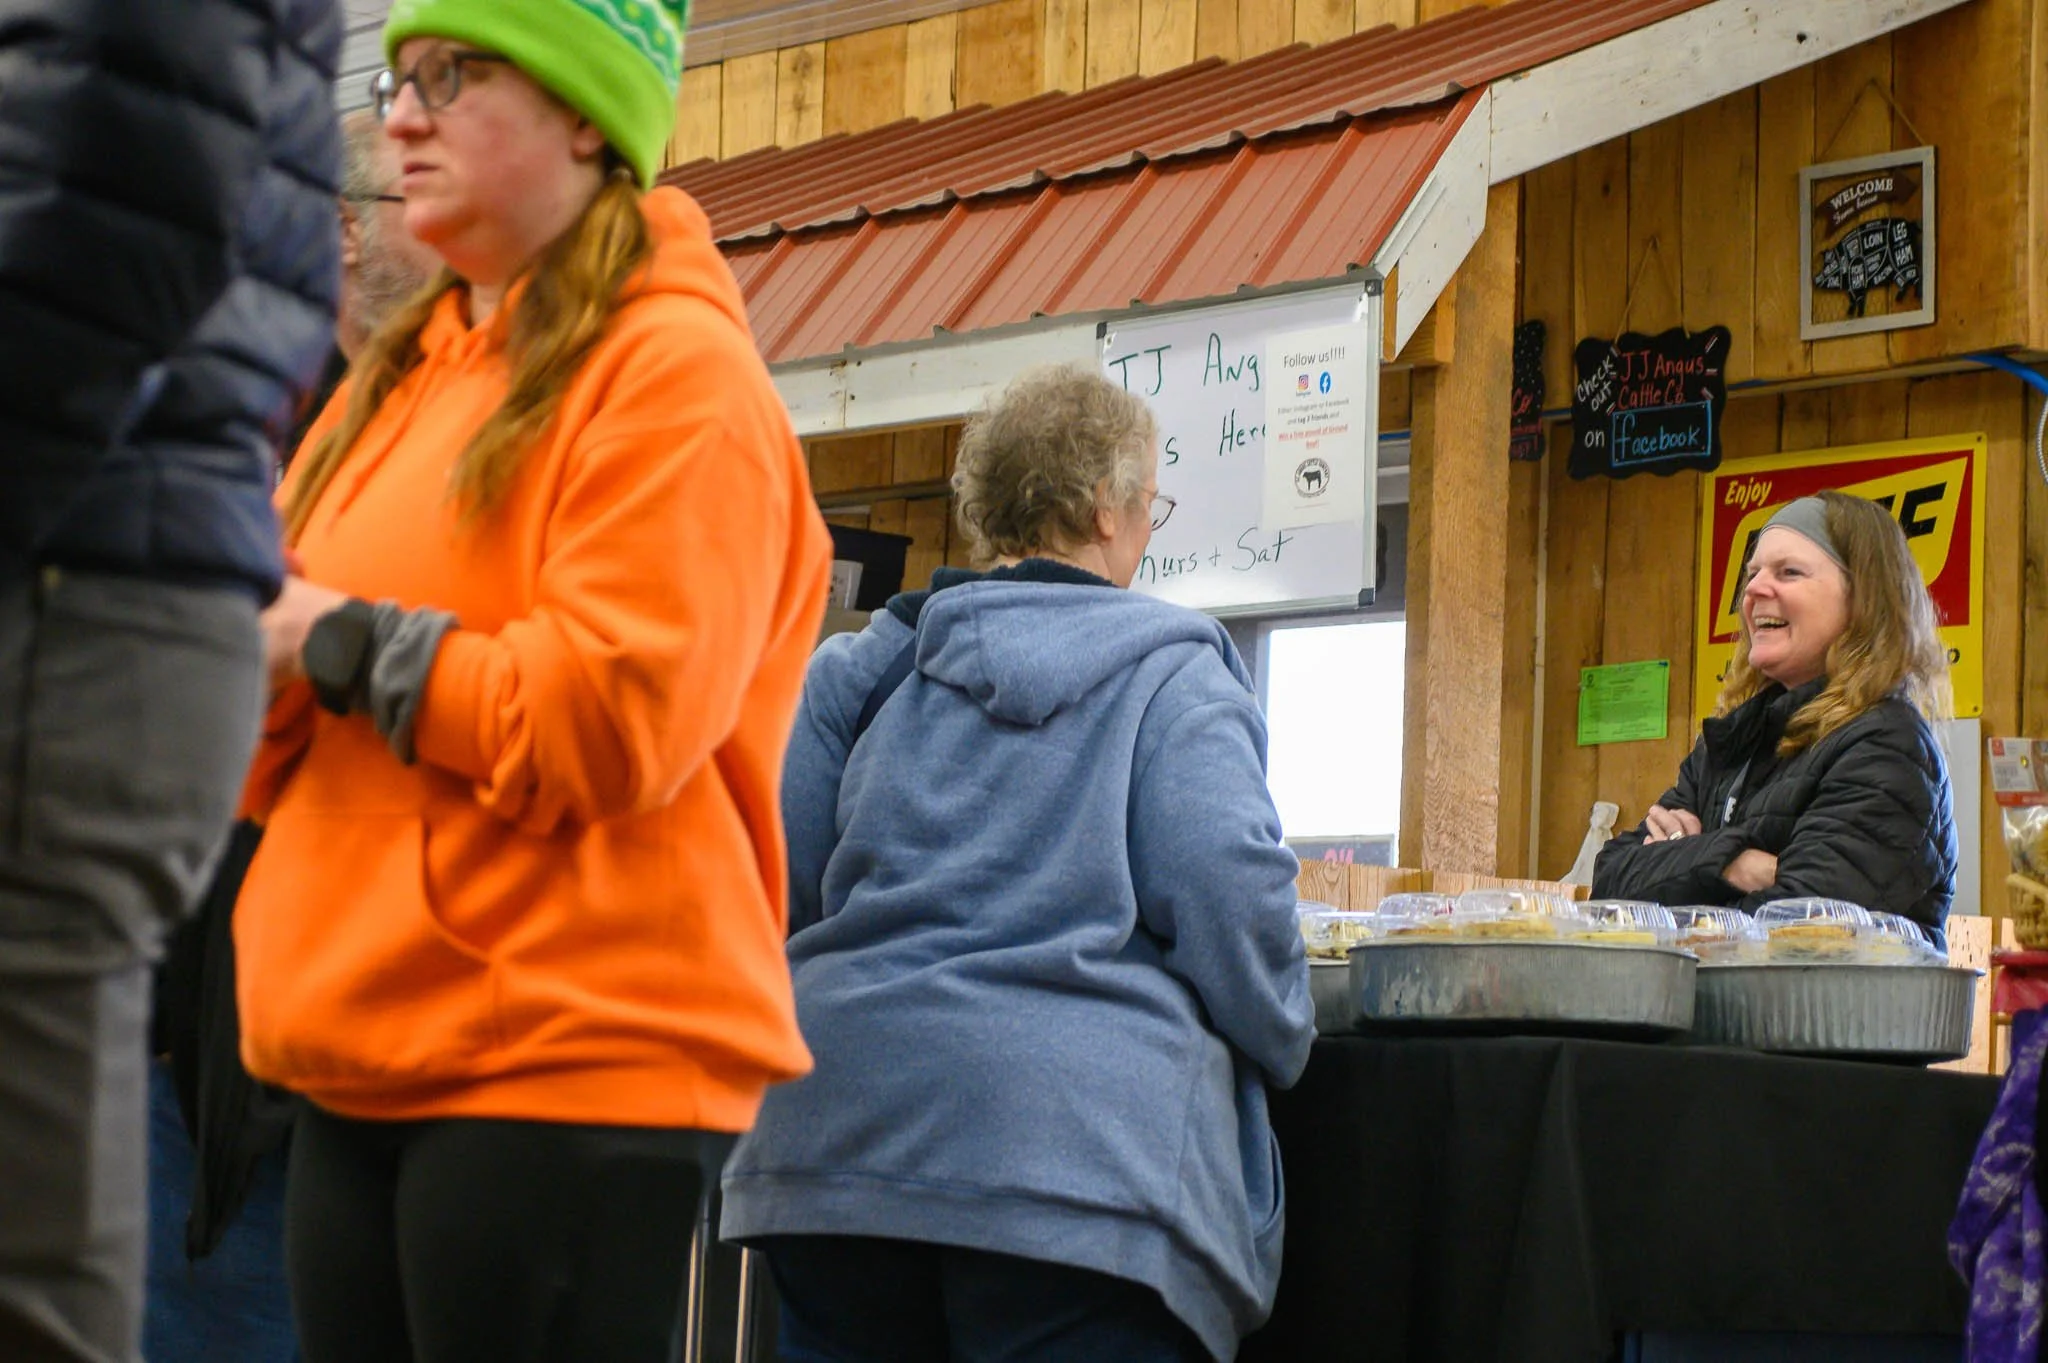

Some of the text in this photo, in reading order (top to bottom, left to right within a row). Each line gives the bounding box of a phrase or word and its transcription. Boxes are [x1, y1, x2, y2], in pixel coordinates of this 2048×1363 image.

[1830, 178, 1893, 209] WELCOME
[1863, 232, 1883, 249] LOIN
[1893, 222, 1907, 242] LEG
[1894, 244, 1913, 266] HAM
[1283, 352, 1316, 369] Follow
[1654, 354, 1705, 386] Angus
[1591, 380, 1613, 411] out
[1618, 383, 1662, 410] Cattle
[1584, 412, 1701, 460] on facebook
[1724, 477, 1773, 510] Enjoy
[1232, 527, 1293, 571] Sat
